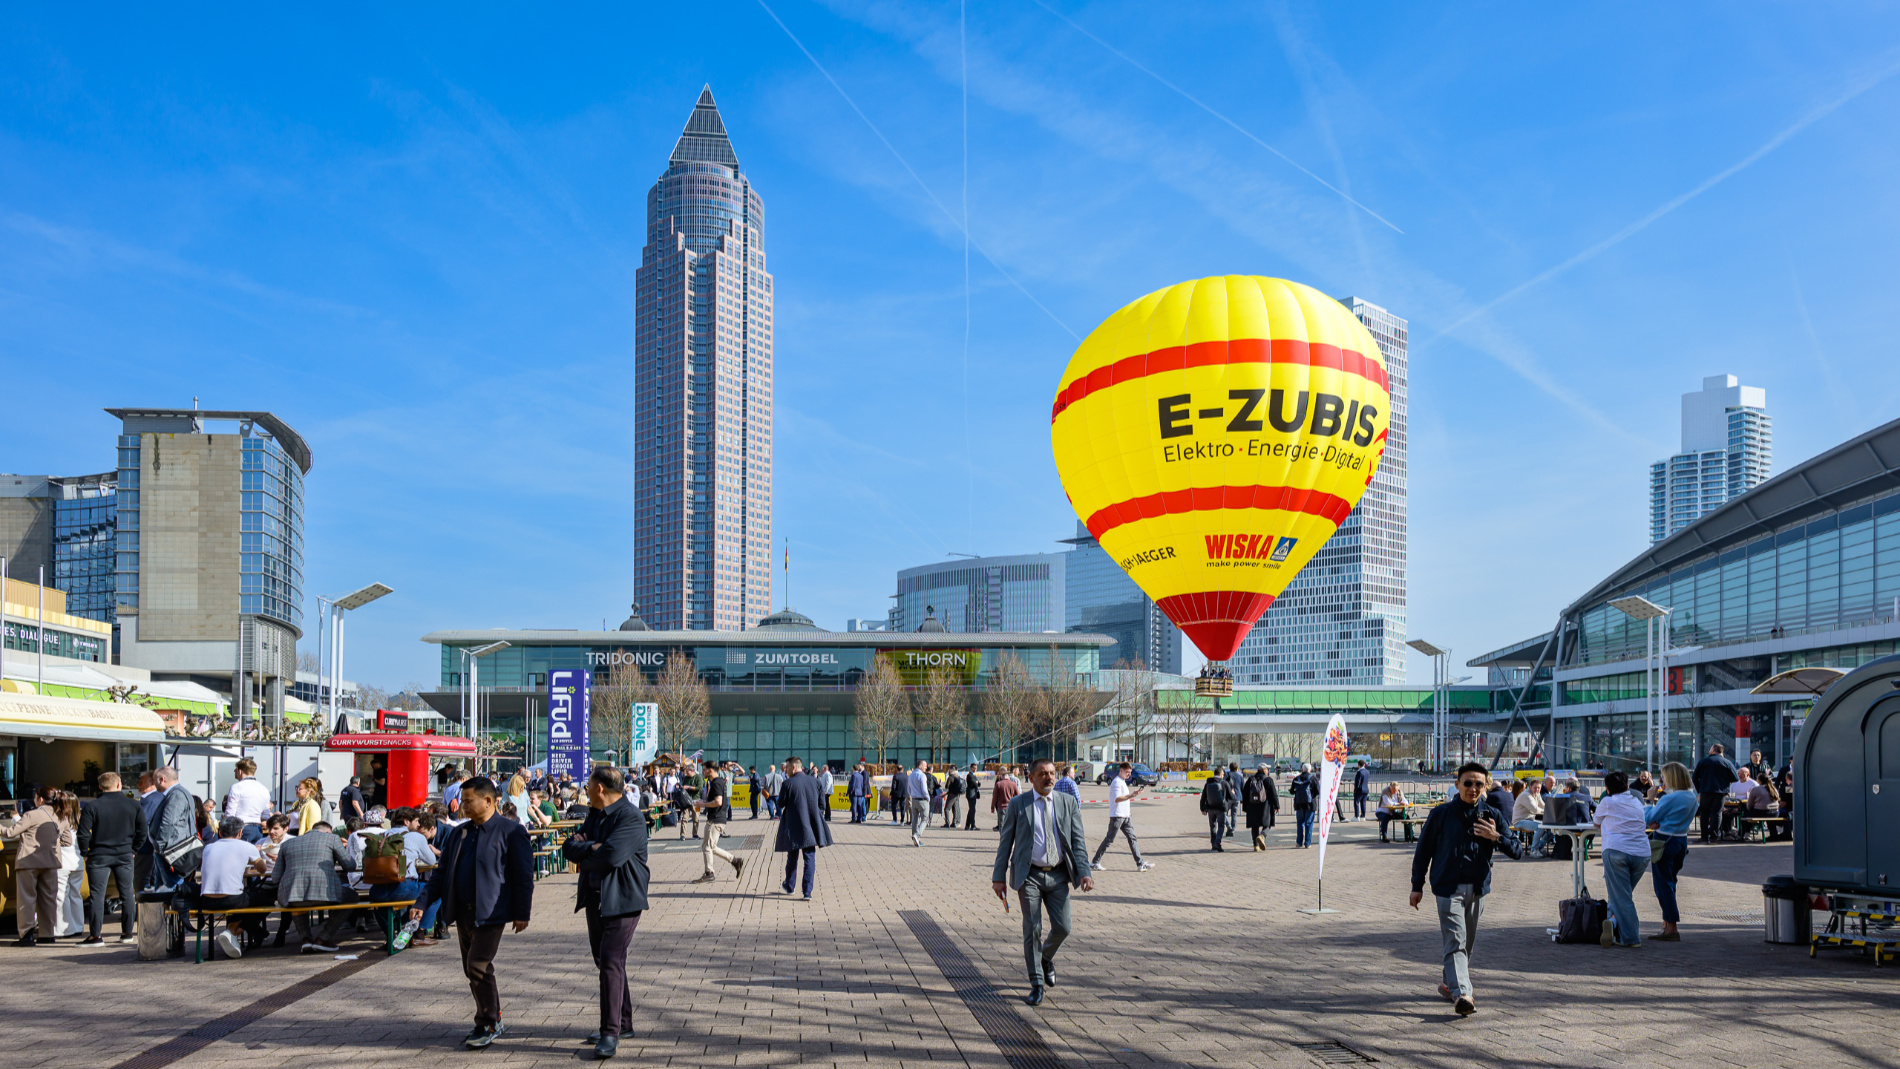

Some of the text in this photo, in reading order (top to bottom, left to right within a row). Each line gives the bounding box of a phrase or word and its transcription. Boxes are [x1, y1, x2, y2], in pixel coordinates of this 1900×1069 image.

[1158, 389, 1378, 447] E-ZUBIS
[1164, 441, 1234, 463] Elektro
[1248, 439, 1319, 463] Energie
[1204, 534, 1274, 560] WISKA
[1207, 560, 1281, 570] make power smile
[20, 629, 61, 645] DIALGUE.
[585, 652, 665, 665] TRIDONIC
[755, 653, 838, 664] ZUMTOBEL
[905, 653, 966, 666] THORN
